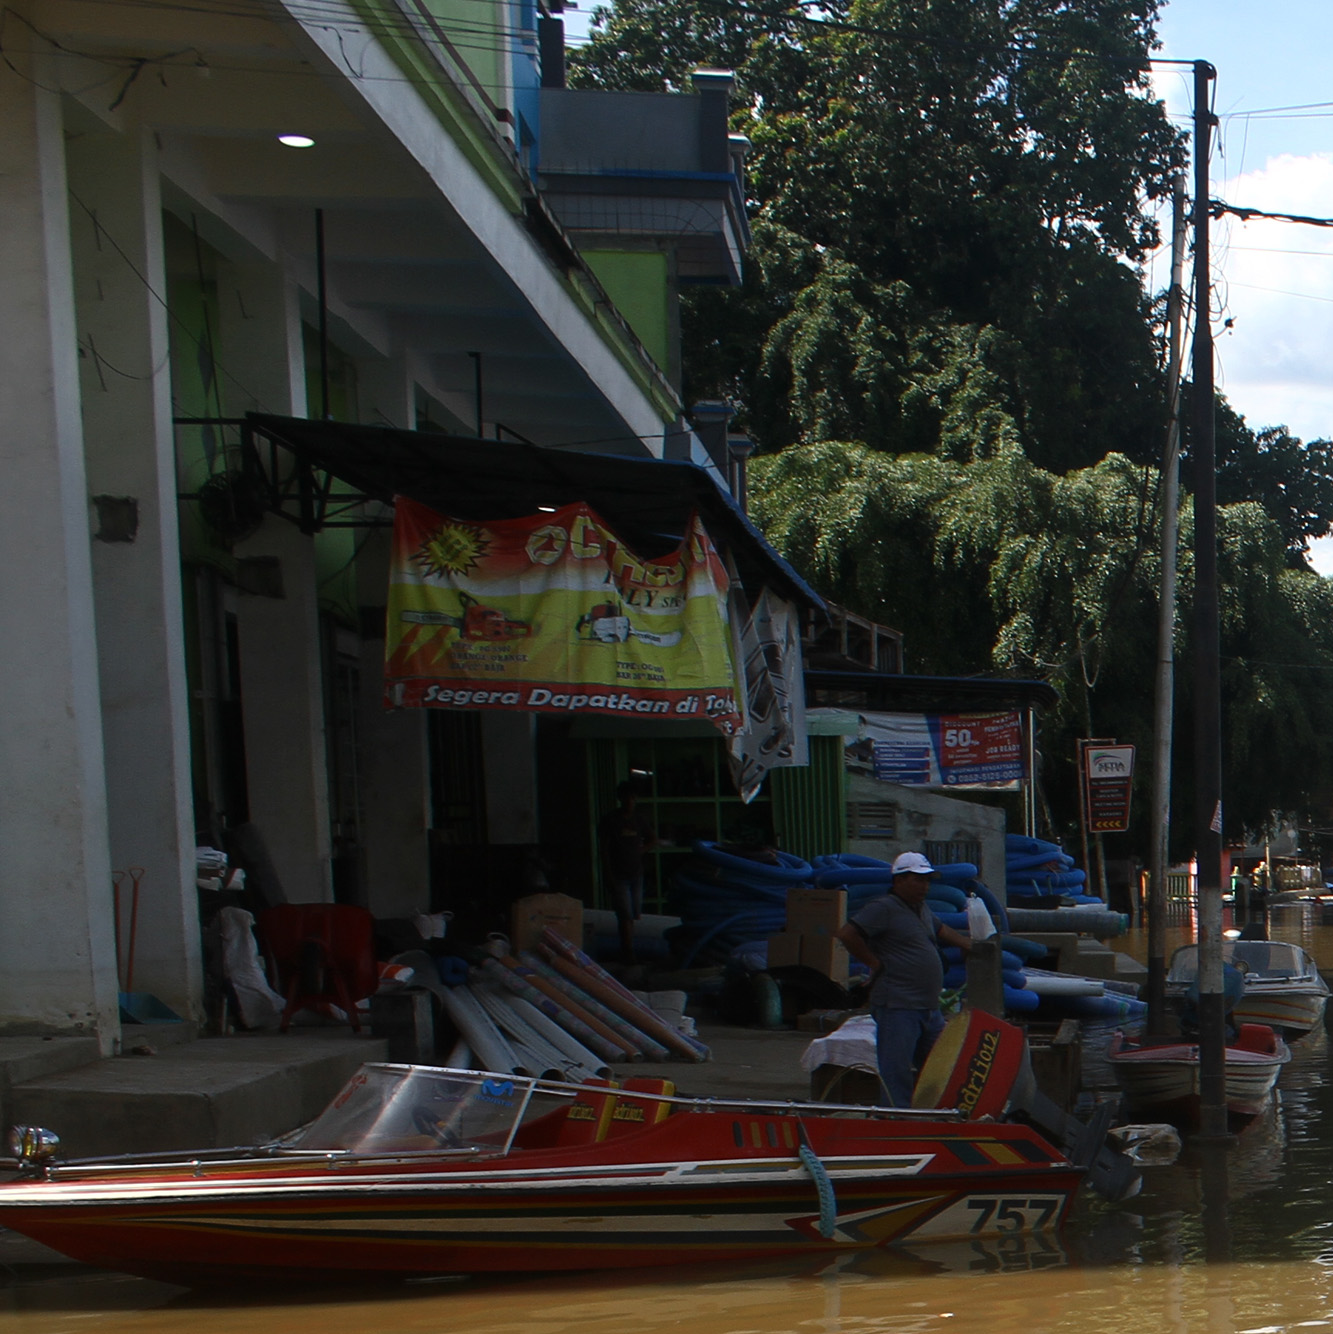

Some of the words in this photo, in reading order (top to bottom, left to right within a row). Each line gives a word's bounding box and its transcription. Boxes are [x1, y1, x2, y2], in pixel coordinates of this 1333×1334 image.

[424, 685, 520, 706] Segera
[527, 687, 670, 714] Dapatkan
[677, 695, 698, 714] di
[966, 1199, 1058, 1233] 757
